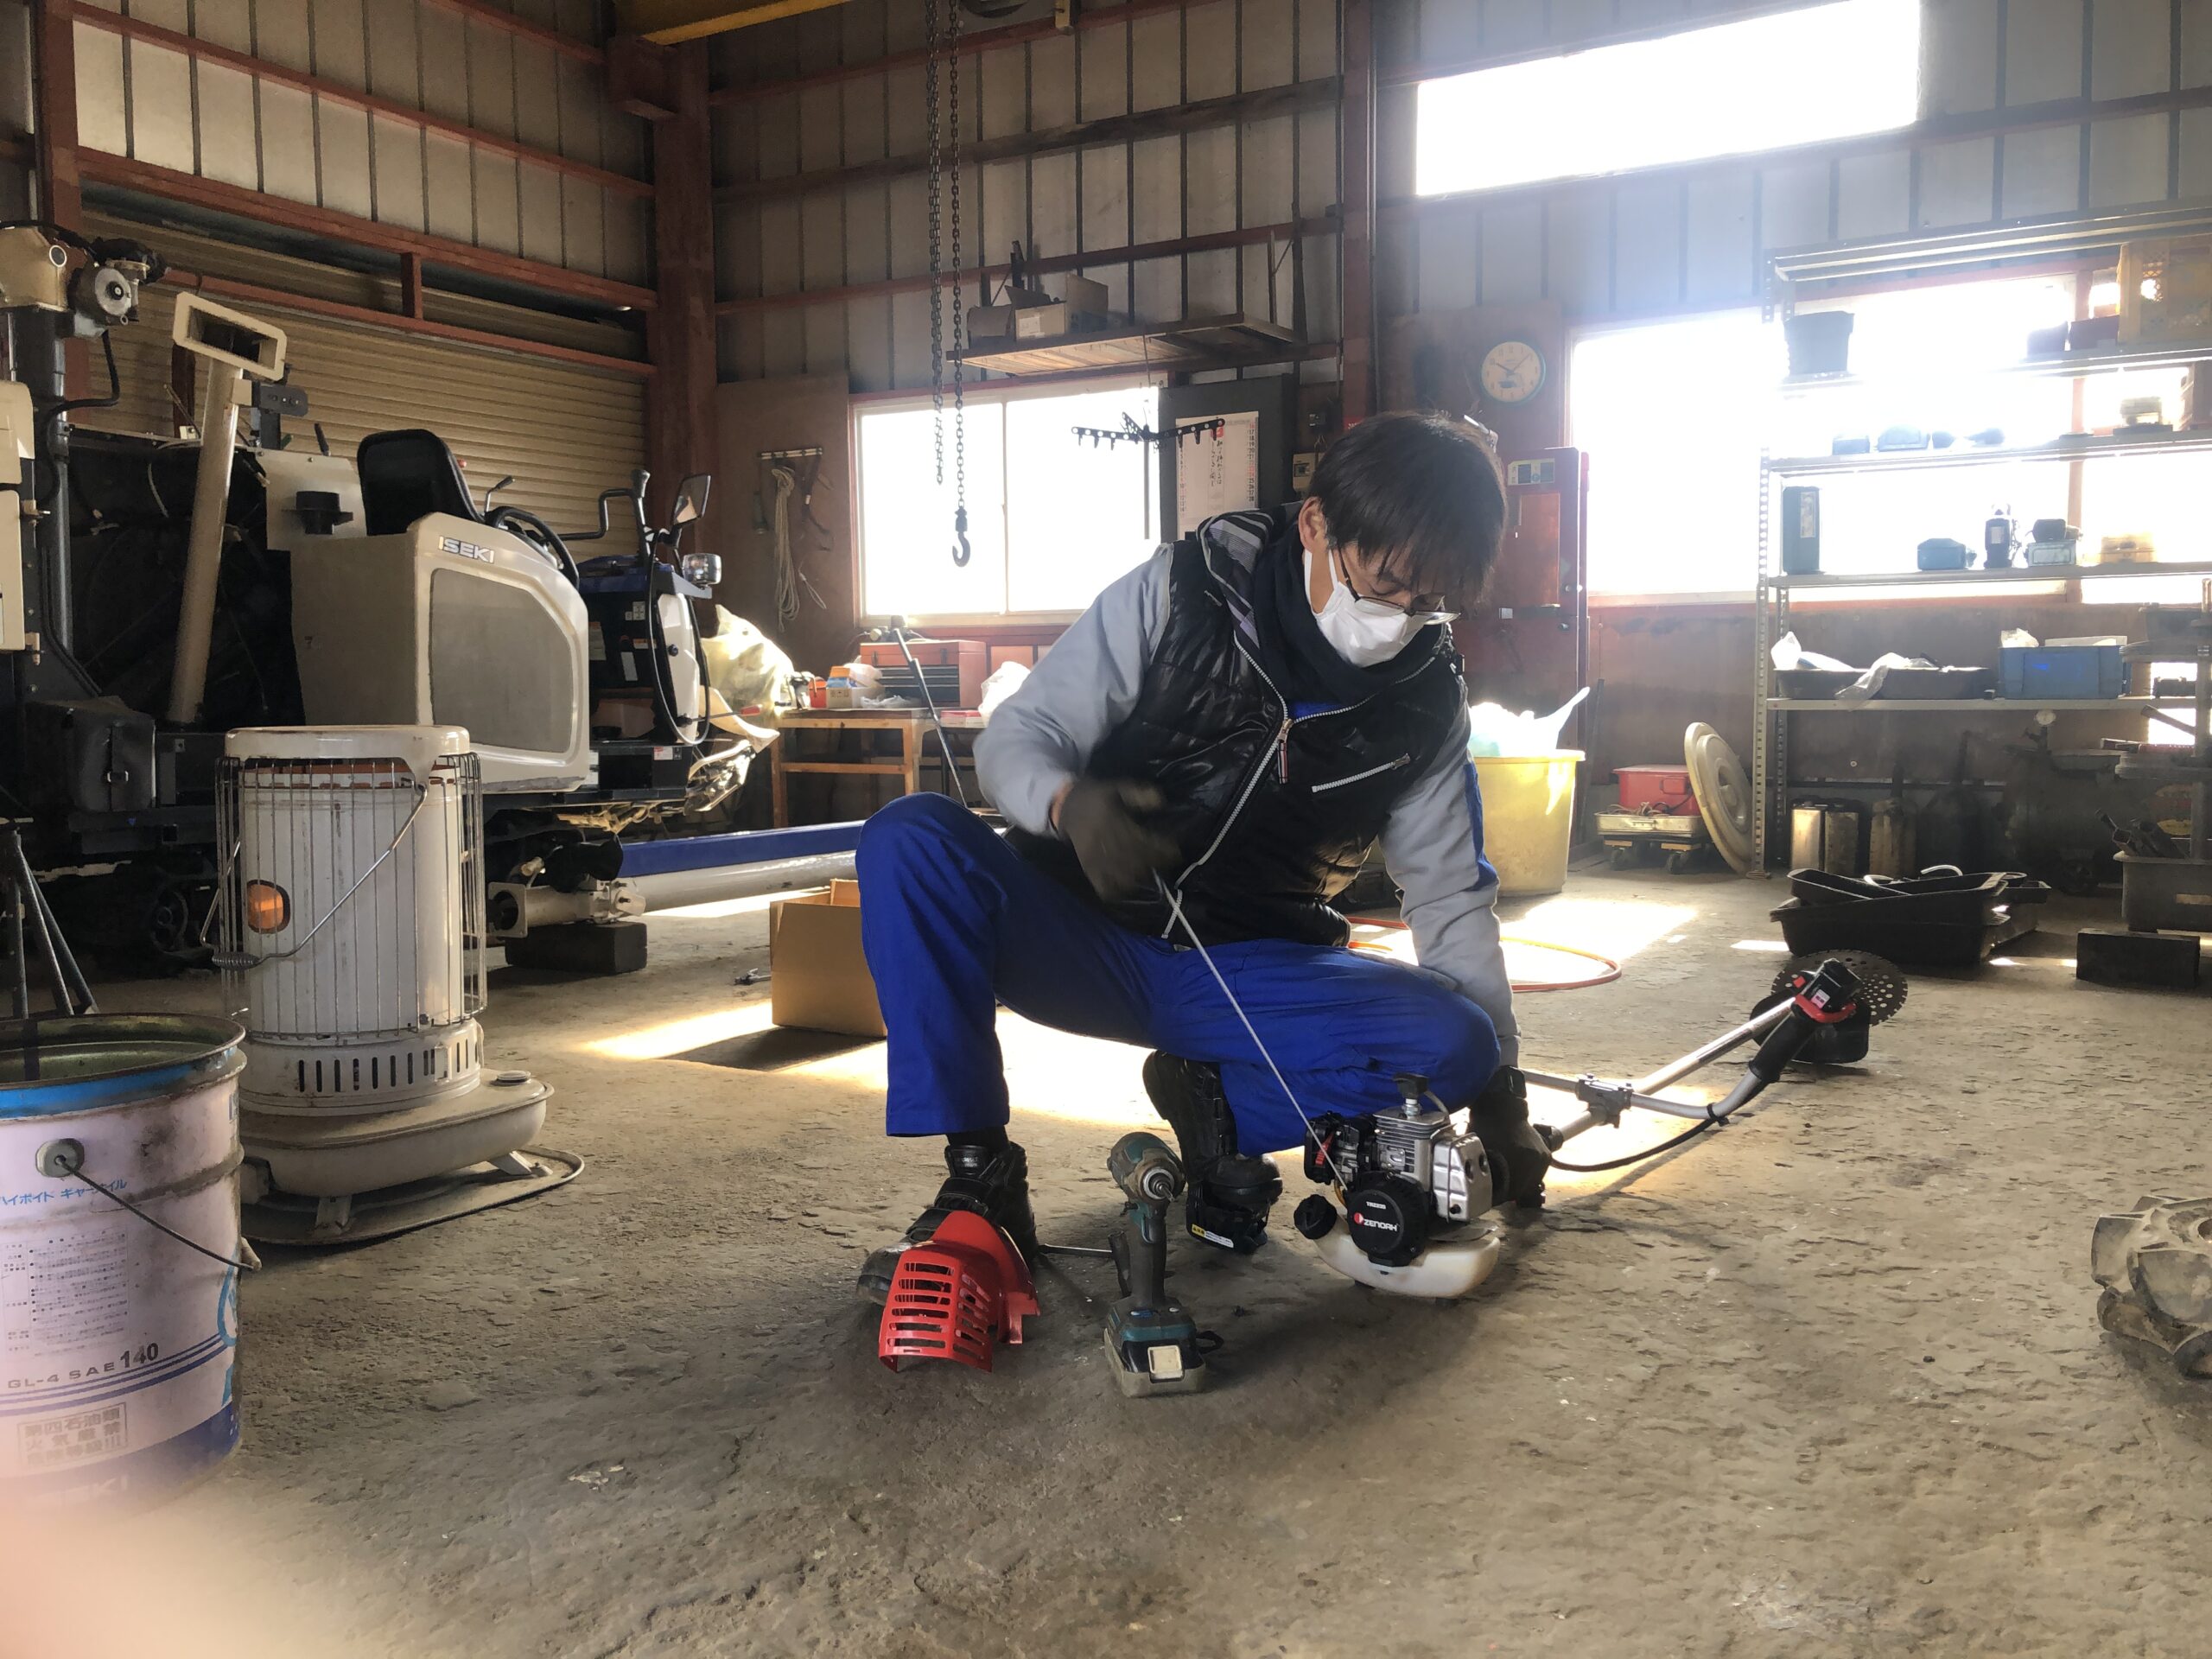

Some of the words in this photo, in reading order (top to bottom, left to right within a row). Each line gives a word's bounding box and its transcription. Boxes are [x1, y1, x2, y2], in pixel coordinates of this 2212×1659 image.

[439, 536, 494, 563] ISEKI
[1363, 1218, 1397, 1232] ZENOAH
[8, 1374, 60, 1389] GL-4
[69, 1362, 115, 1380] SAE
[120, 1343, 159, 1369] 140
